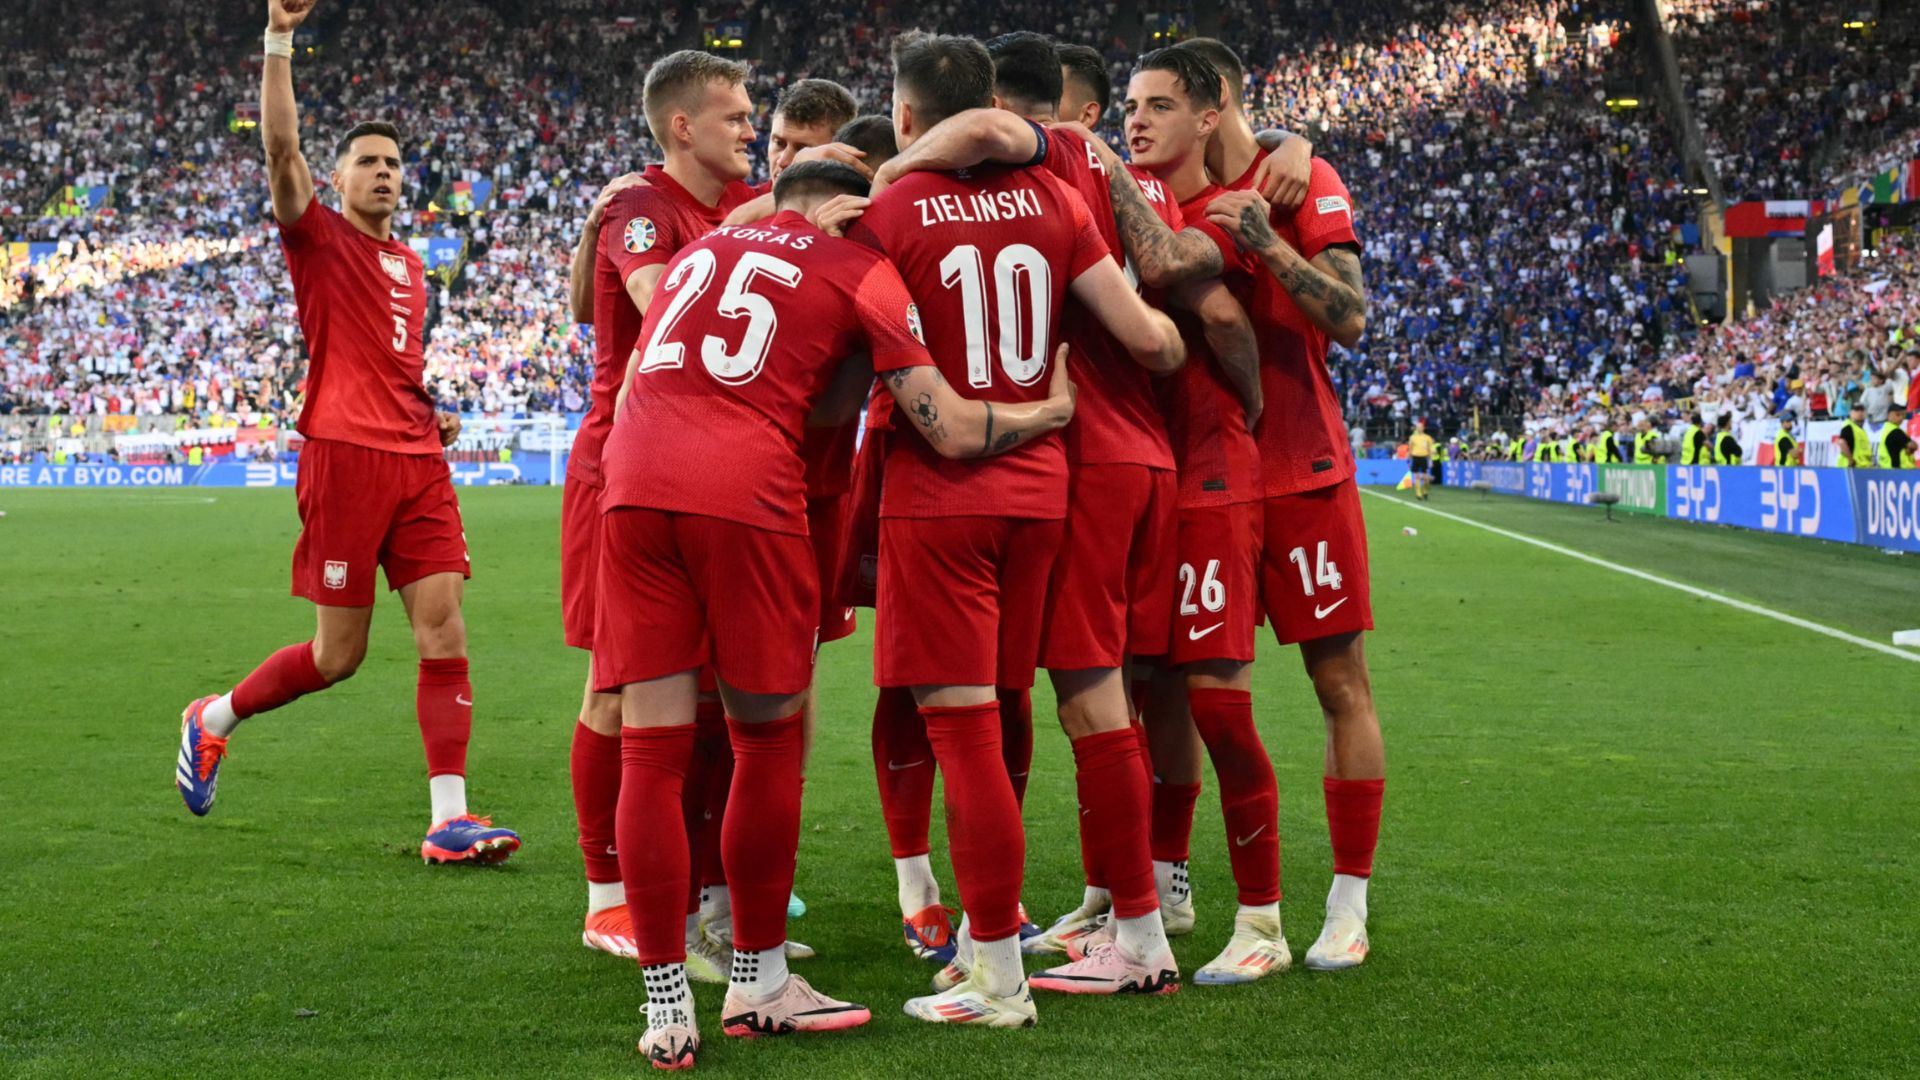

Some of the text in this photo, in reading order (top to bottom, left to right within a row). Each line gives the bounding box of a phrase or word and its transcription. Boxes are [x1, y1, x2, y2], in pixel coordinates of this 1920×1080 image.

[913, 188, 1043, 227] ZIELIŃSKI
[434, 247, 455, 261] 13
[392, 314, 407, 352] 5
[638, 248, 803, 386] 25
[939, 243, 1051, 389] 10
[37, 467, 67, 484] AT
[74, 467, 183, 484] BYD.COM
[1676, 466, 1721, 521] BYD
[1760, 468, 1821, 535] BYD
[1179, 559, 1226, 616] 26
[1289, 540, 1342, 597] 14
